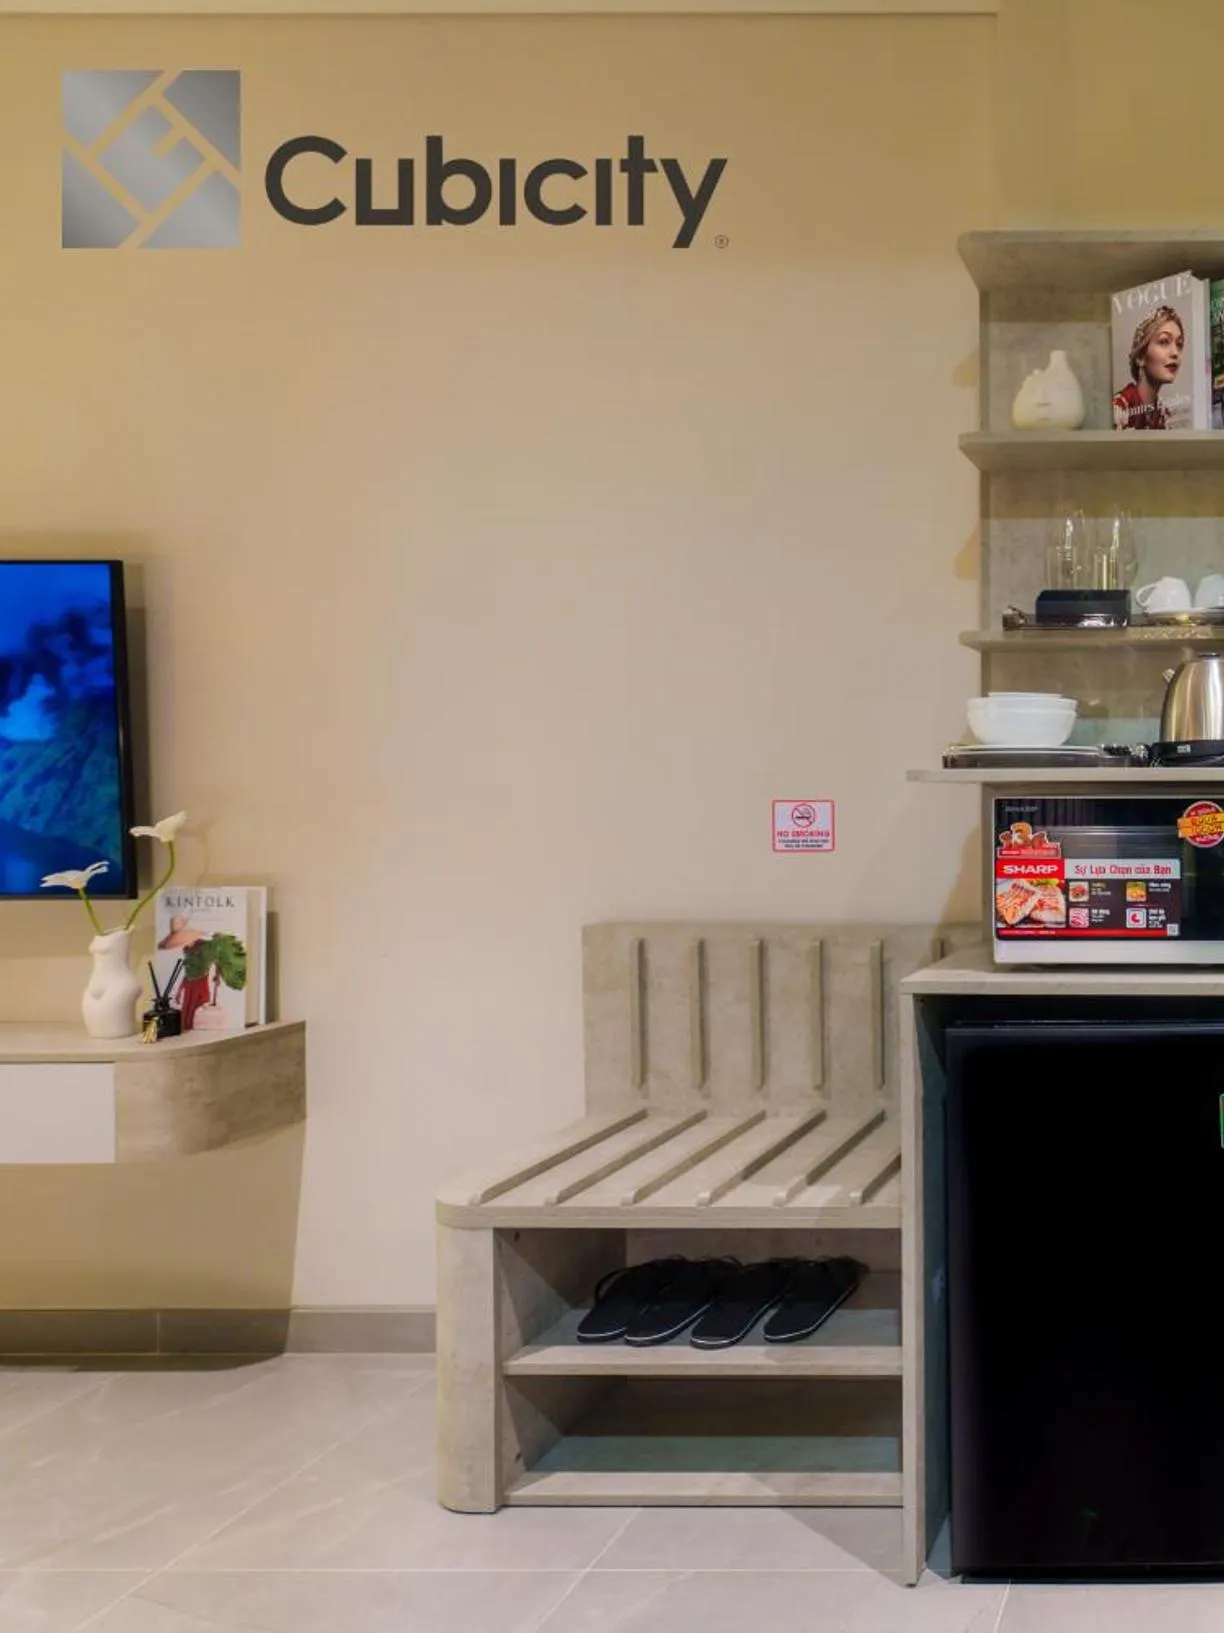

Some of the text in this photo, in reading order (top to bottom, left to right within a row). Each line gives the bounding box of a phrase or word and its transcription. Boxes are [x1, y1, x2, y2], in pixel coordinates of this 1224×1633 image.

[1112, 274, 1191, 315] VOGUE
[1003, 865, 1058, 874] SHARP
[165, 895, 234, 908] KINFOLK
